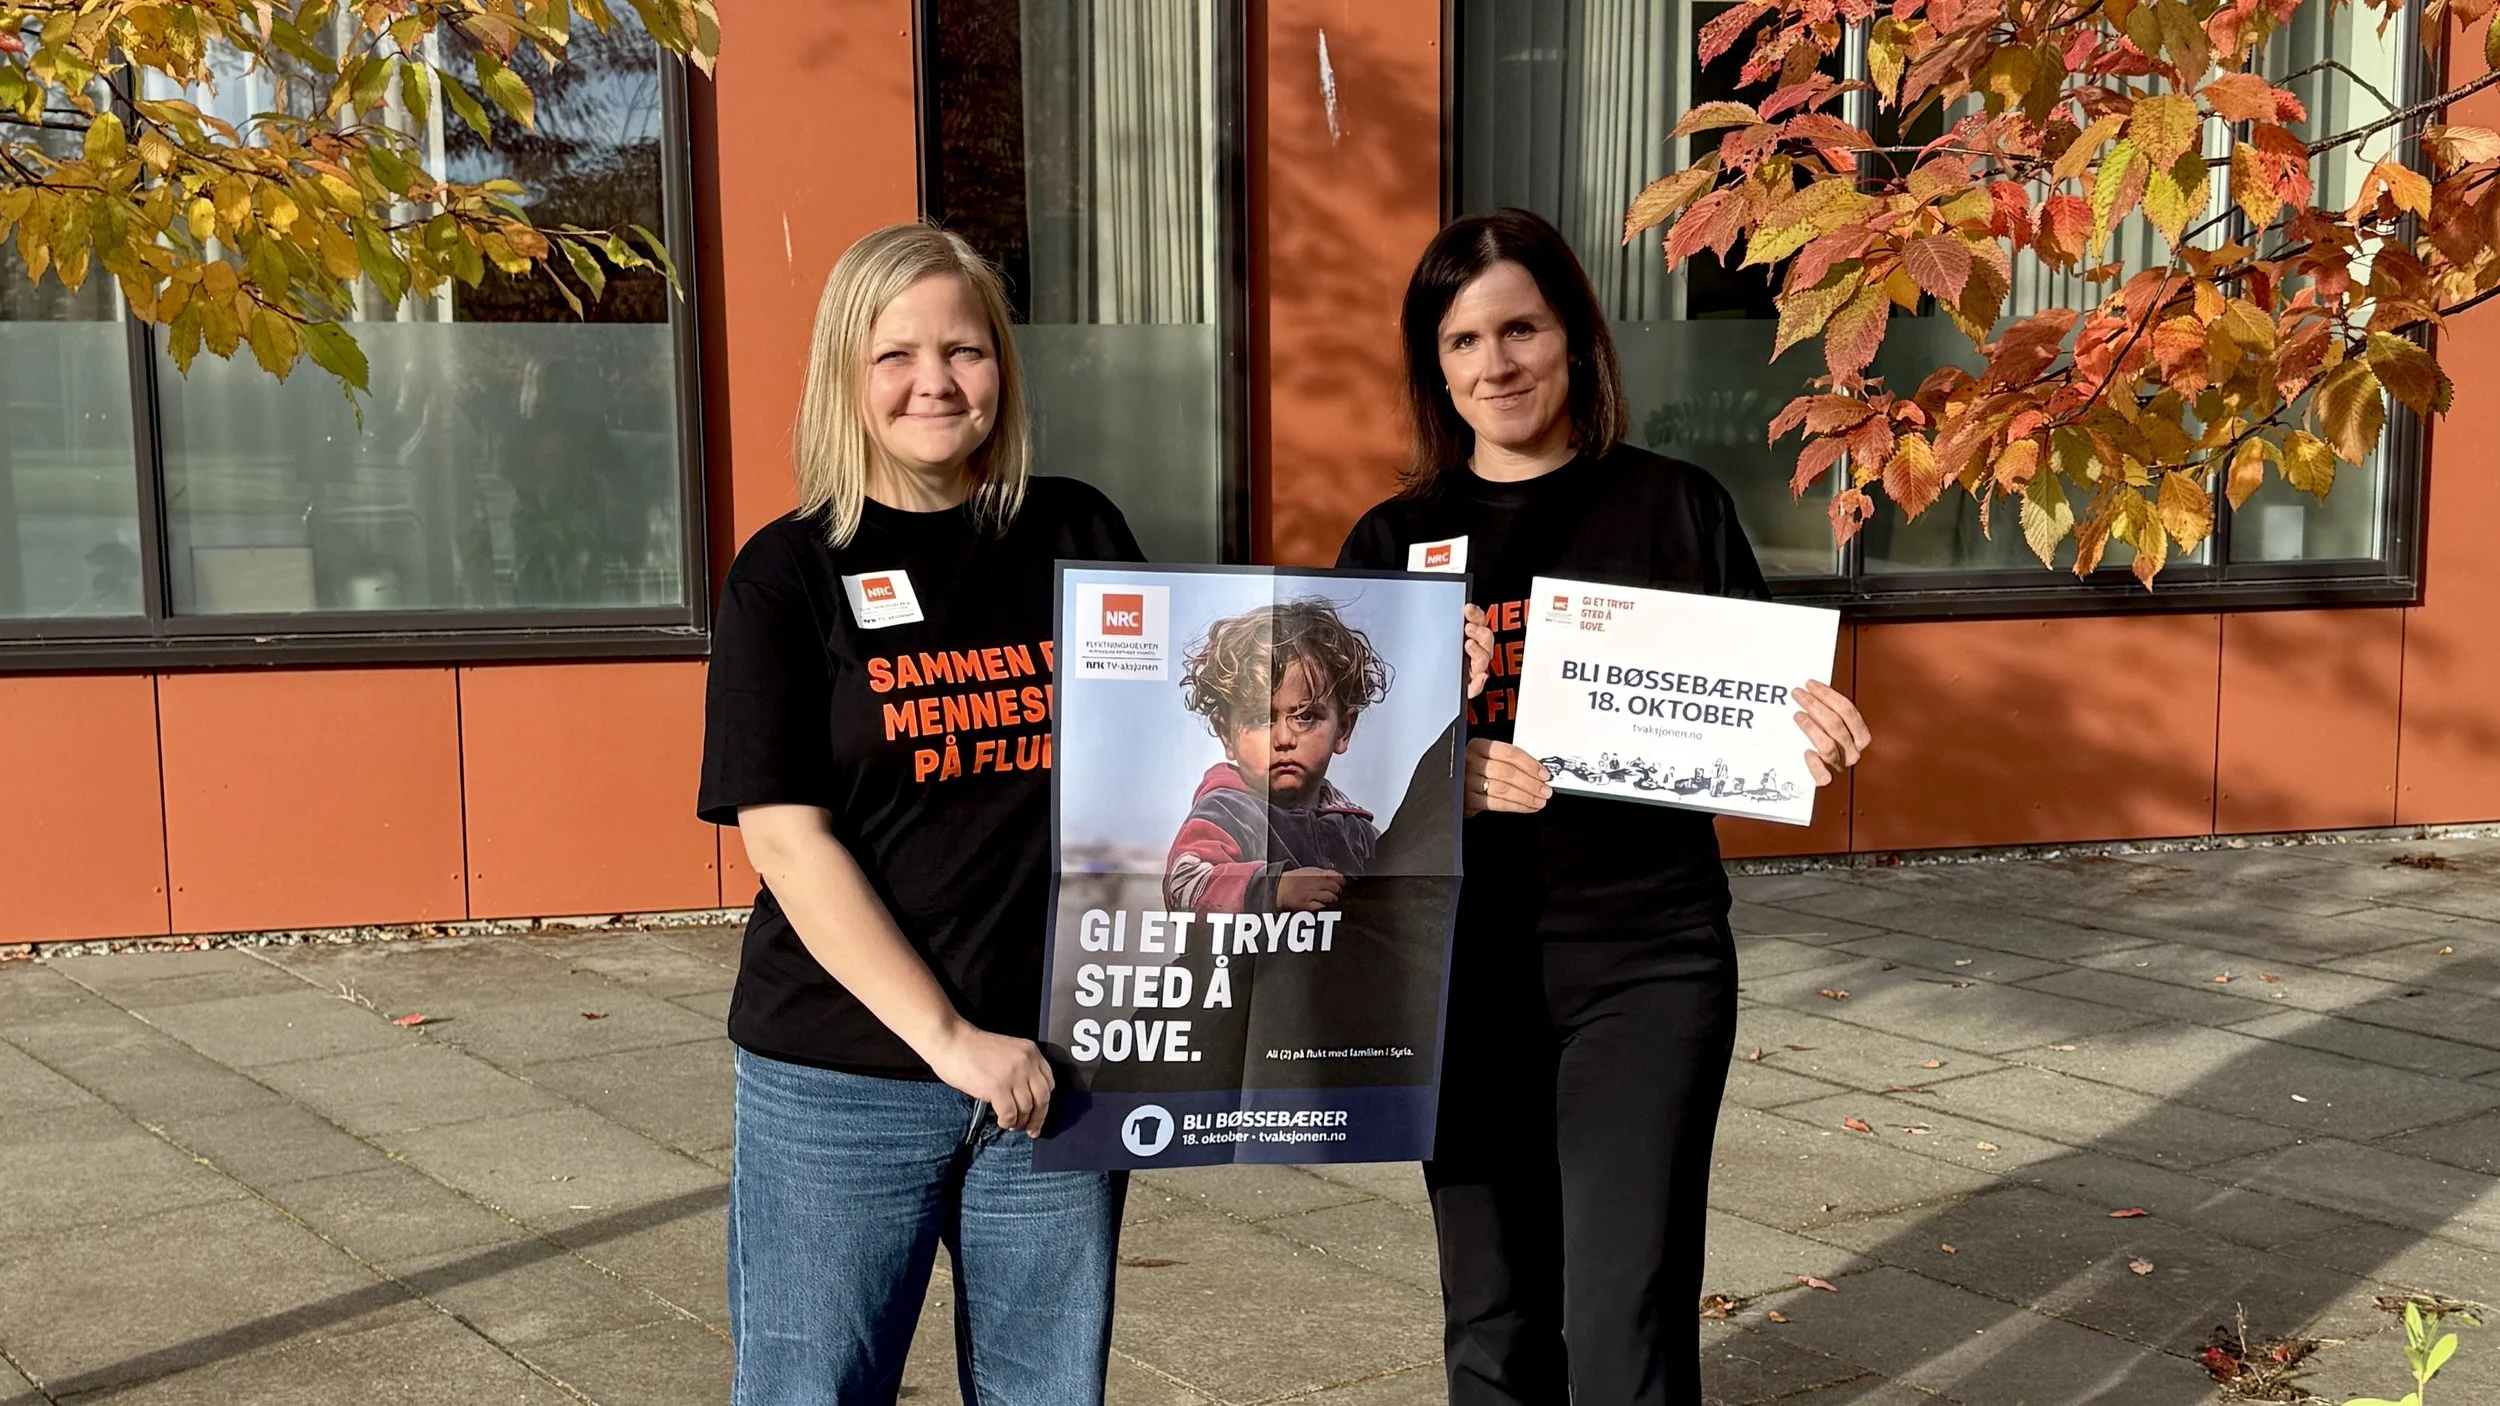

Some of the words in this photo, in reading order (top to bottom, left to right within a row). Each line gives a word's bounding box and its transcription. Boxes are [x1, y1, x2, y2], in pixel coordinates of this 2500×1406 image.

[866, 586, 893, 598] NRC
[1106, 611, 1139, 627] NRC
[867, 644, 1037, 693] SAMMEN
[1561, 660, 1600, 683] BLI
[1606, 665, 1788, 706] BØSSEBÆRER
[1588, 690, 1621, 713] 18.
[1627, 695, 1754, 729] OKTOBER
[1632, 724, 1703, 741] tvaksjonen.no
[914, 735, 962, 783] PÅ
[1079, 909, 1127, 953] GI
[1138, 911, 1196, 954] ET
[1207, 911, 1342, 955] TRYGT
[1074, 963, 1193, 1008] STED
[1202, 954, 1234, 1009] Å
[1070, 1020, 1202, 1063] SOVE.
[1182, 1133, 1198, 1145] 18.
[1200, 1130, 1249, 1144] oktober
[1259, 1130, 1346, 1144] tvaksjonen.no
[1183, 1113, 1211, 1131] BLI
[1215, 1110, 1347, 1128] BØSSEBÆRER
